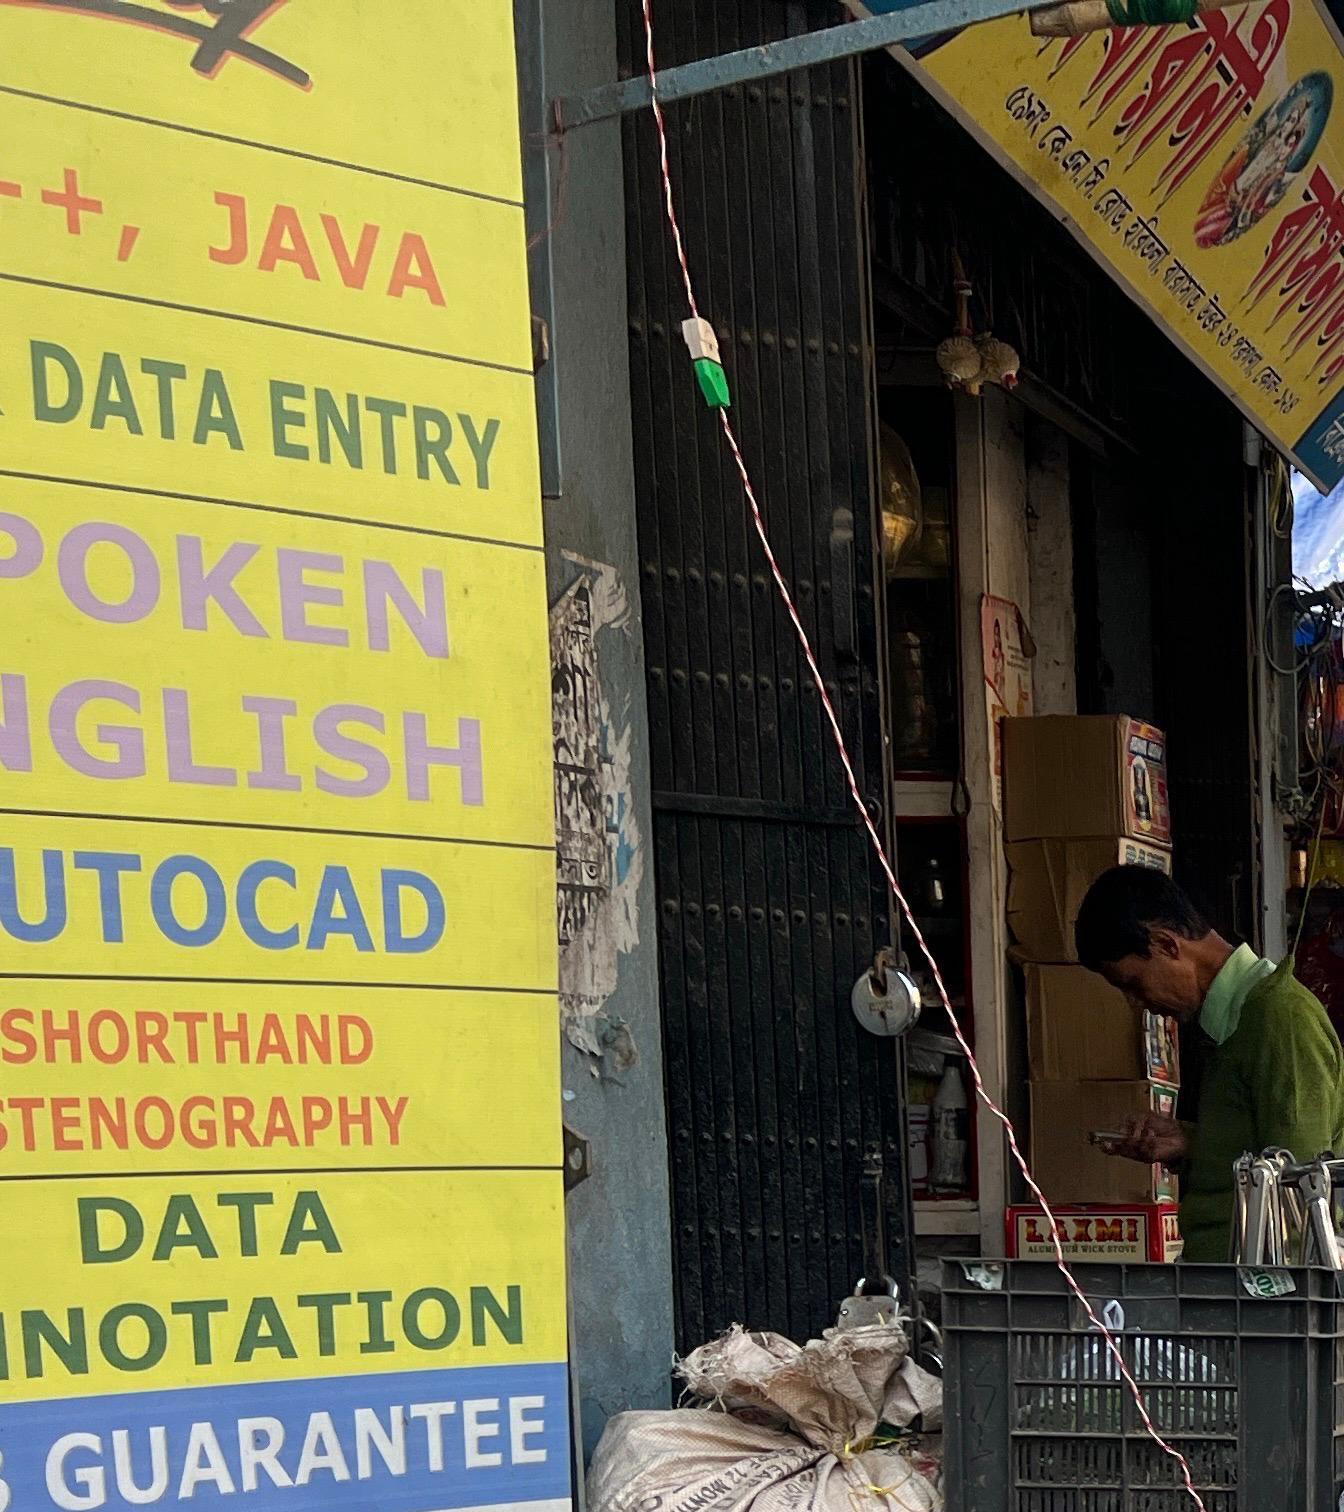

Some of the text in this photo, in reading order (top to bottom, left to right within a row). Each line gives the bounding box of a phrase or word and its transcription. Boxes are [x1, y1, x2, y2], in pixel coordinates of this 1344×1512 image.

[208, 191, 447, 308] JAVA
[29, 338, 500, 490] DATA ENTRY
[0, 1008, 375, 1066] SHORTHAND
[0, 1095, 410, 1152] TENOGRAPHY
[77, 1190, 343, 1265] DATA
[1024, 1217, 1139, 1244] LAXMI
[0, 1284, 524, 1381] NOTATION
[44, 1395, 549, 1512] GUARANTEE
